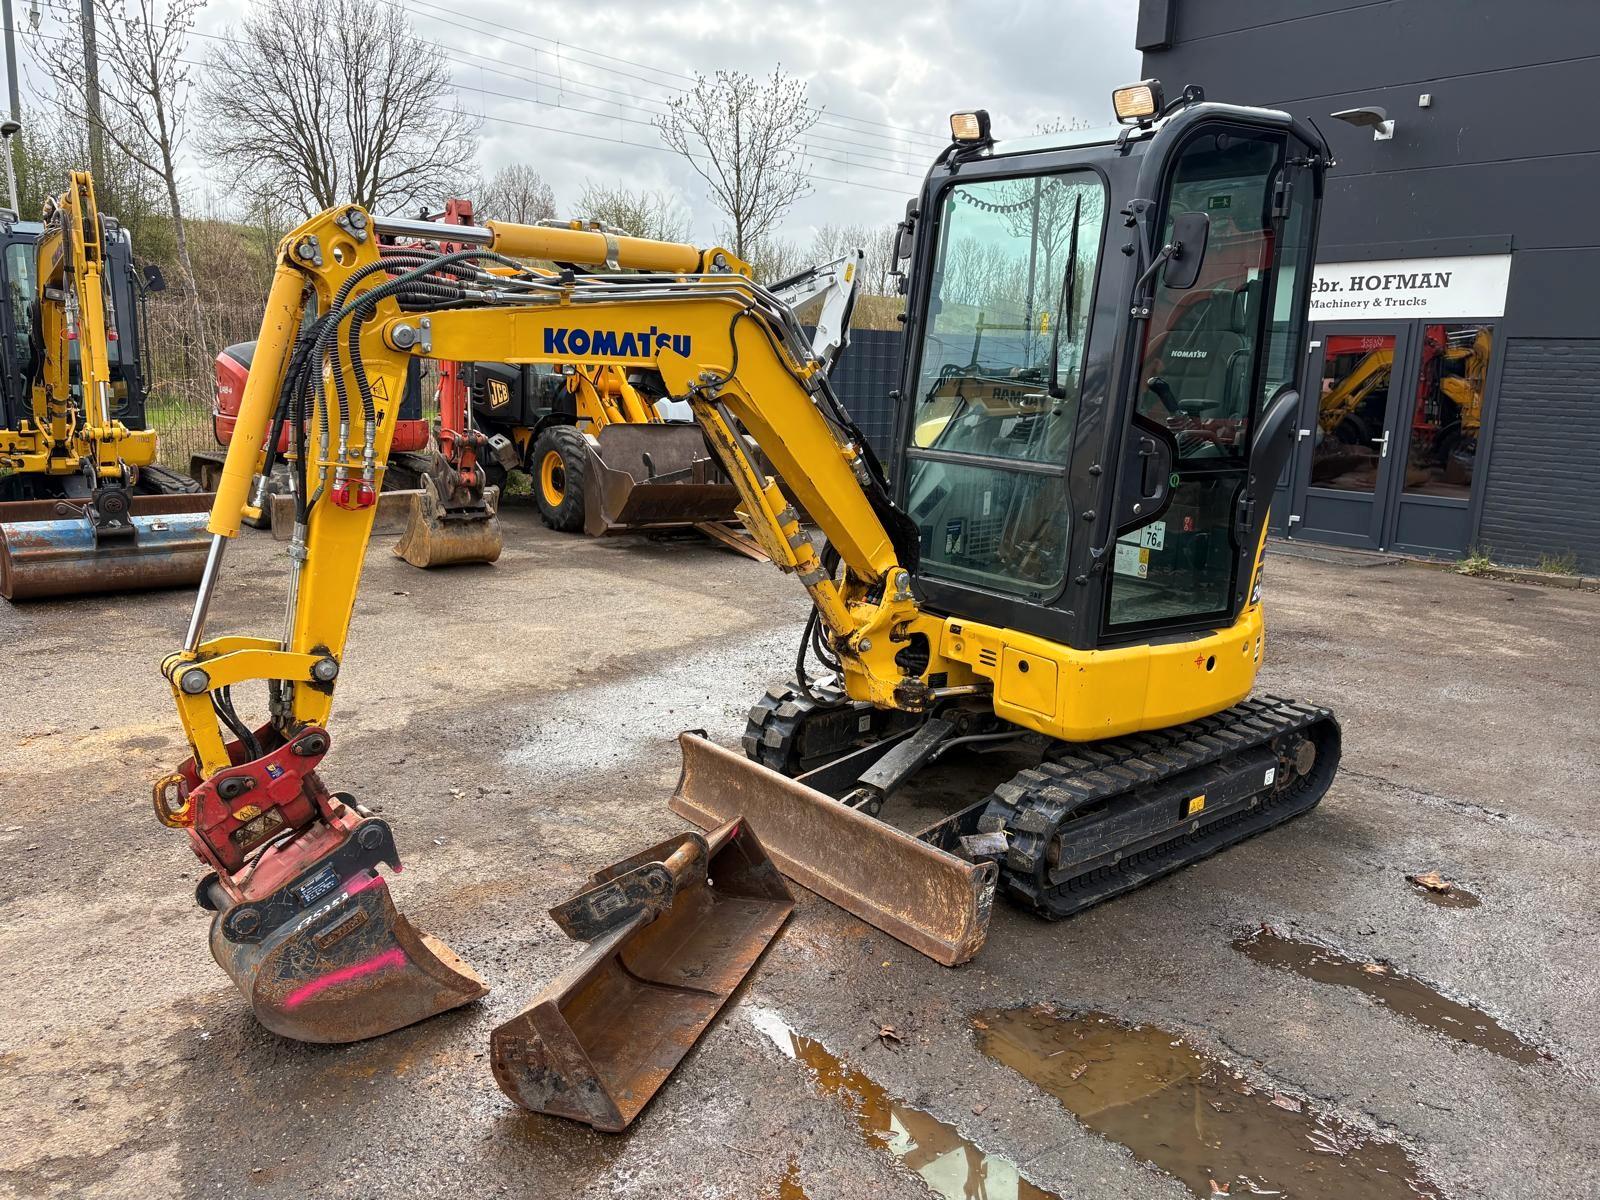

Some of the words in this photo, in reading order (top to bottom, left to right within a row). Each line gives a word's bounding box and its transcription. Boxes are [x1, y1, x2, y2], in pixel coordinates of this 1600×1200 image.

[1310, 278, 1343, 292] ebr.
[1348, 272, 1452, 291] HOFMAN
[1309, 299, 1369, 309] Machinery
[1372, 298, 1382, 307] &
[1384, 297, 1427, 307] Trucks
[543, 326, 691, 358] KOMATSU
[1171, 350, 1208, 358] KOMATSU
[490, 381, 508, 406] JCB
[1146, 532, 1157, 546] 76
